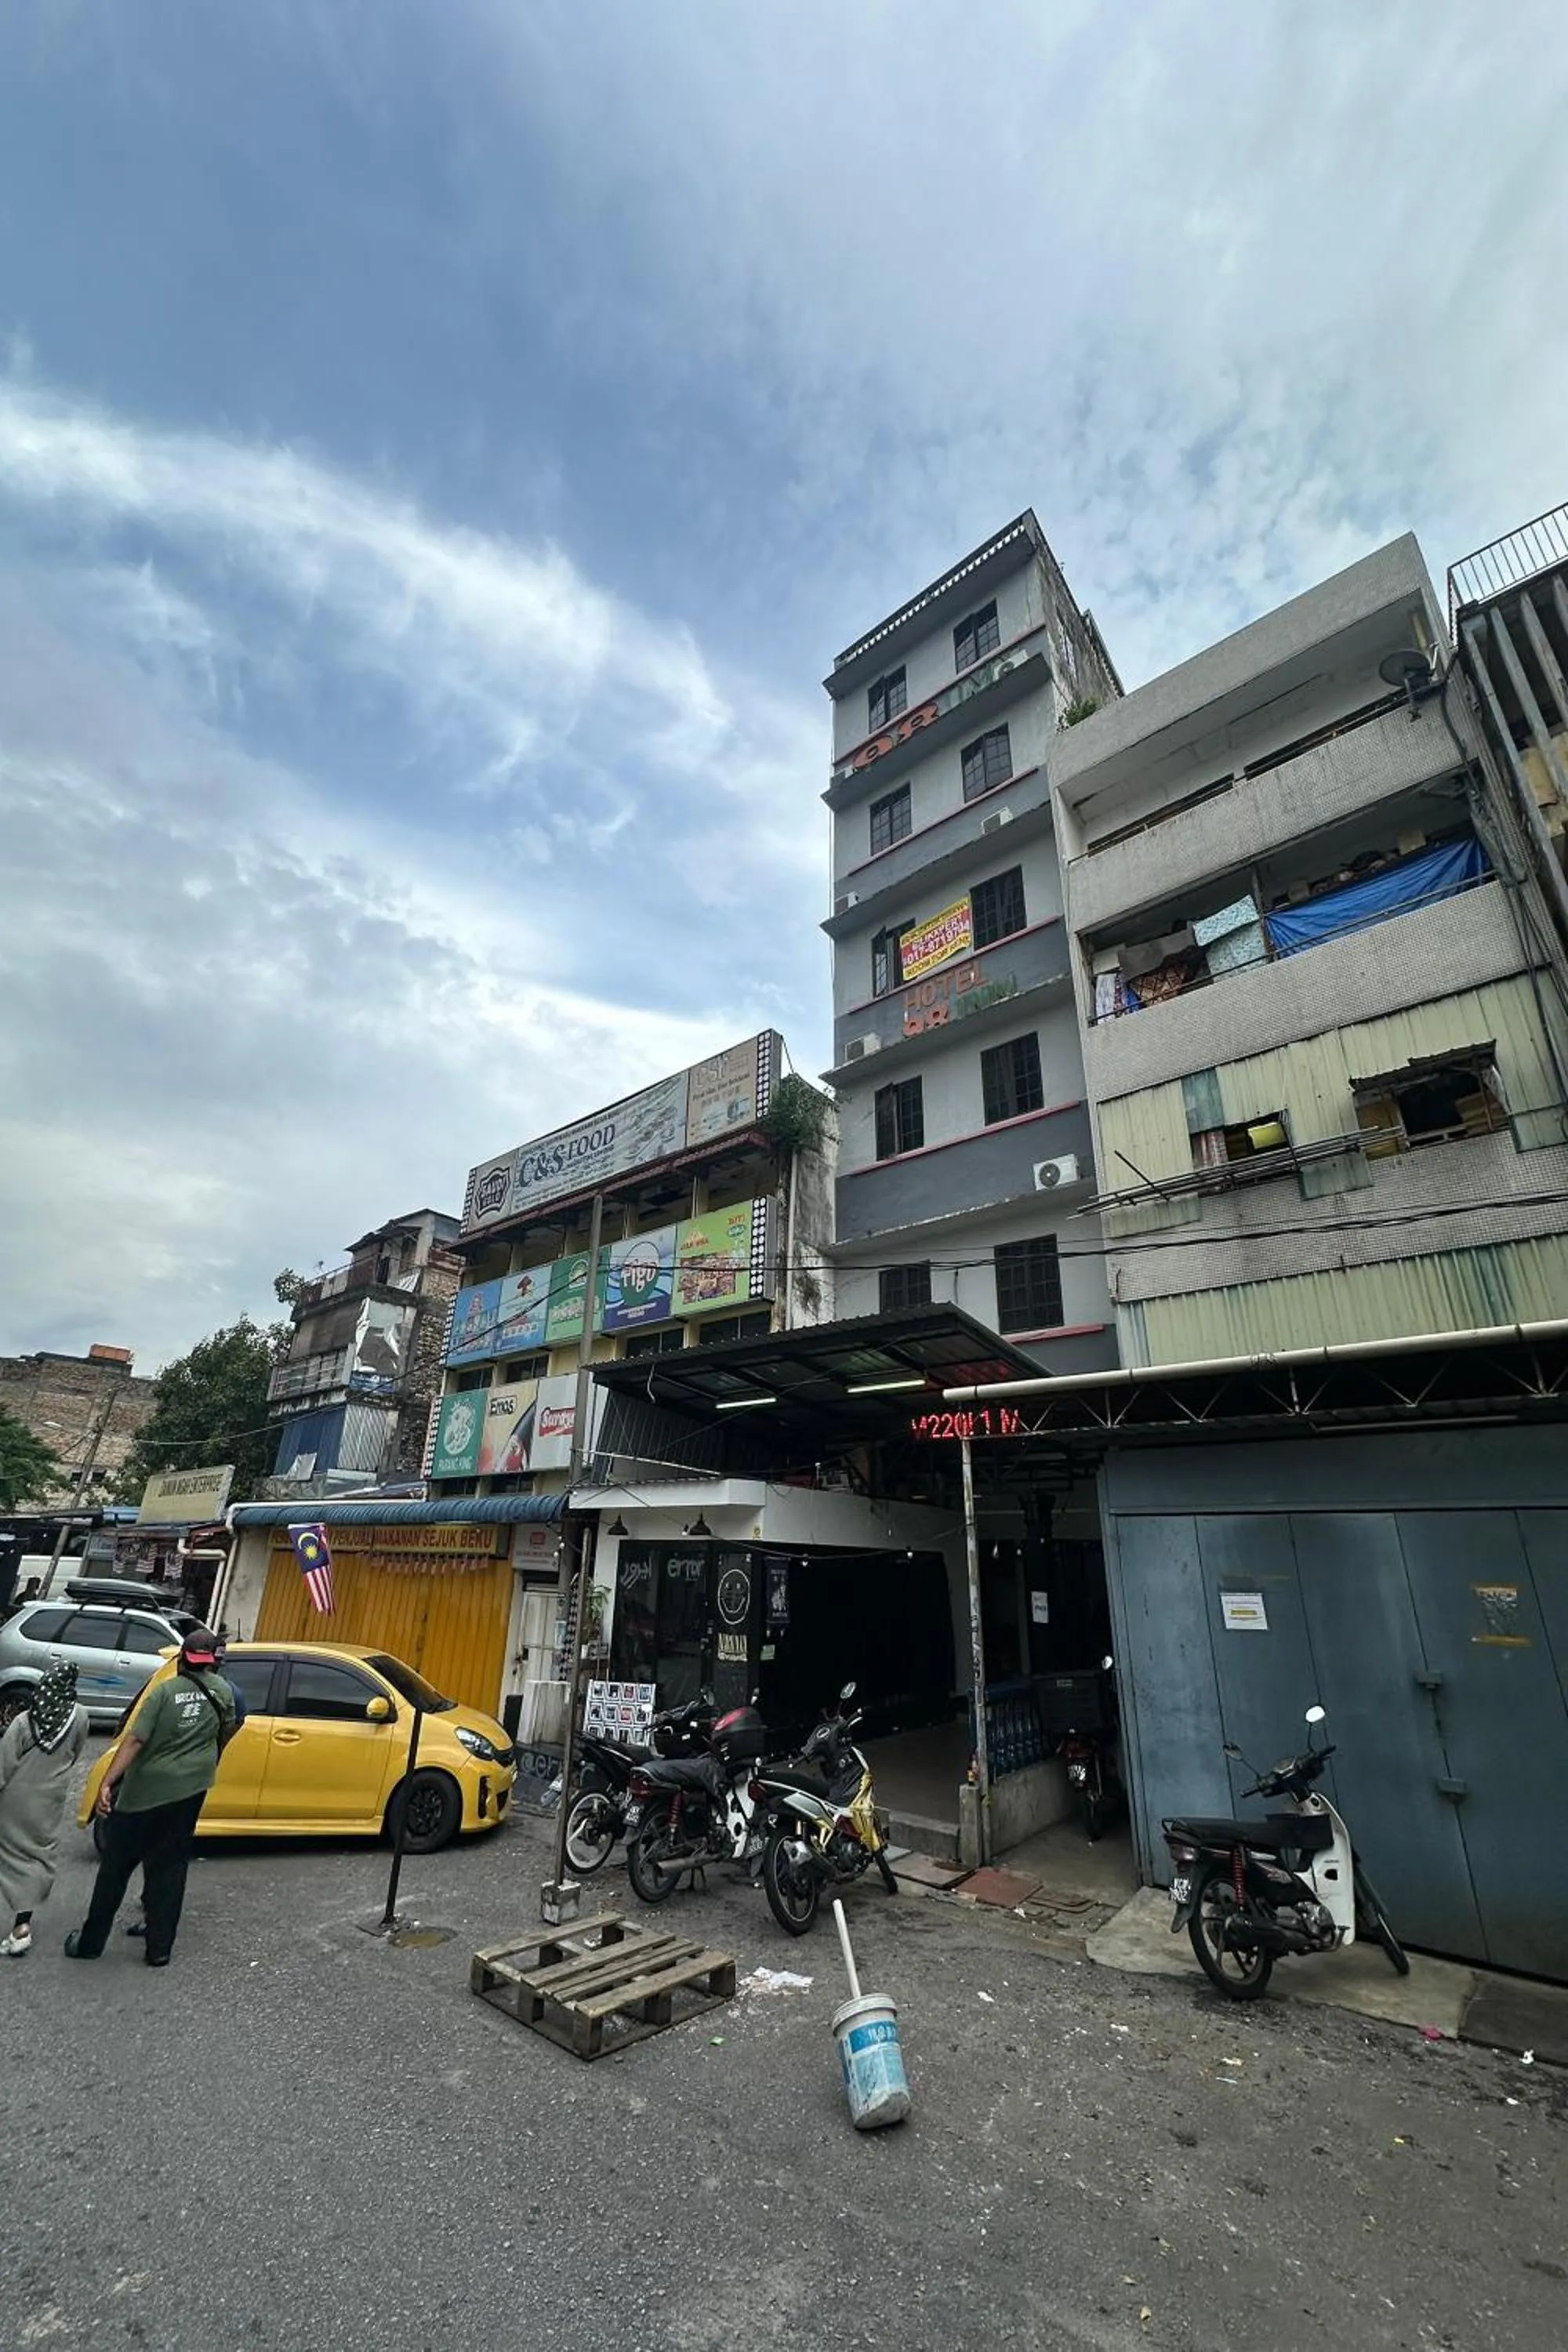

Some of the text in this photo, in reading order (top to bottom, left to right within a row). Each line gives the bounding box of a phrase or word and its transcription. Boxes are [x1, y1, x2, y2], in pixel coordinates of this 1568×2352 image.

[905, 960, 991, 1011] HOTEL
[568, 1123, 615, 1160] FOOD
[375, 1530, 421, 1548] MAKANAN
[423, 1529, 458, 1548] SEJUK
[459, 1528, 494, 1549] BEKU
